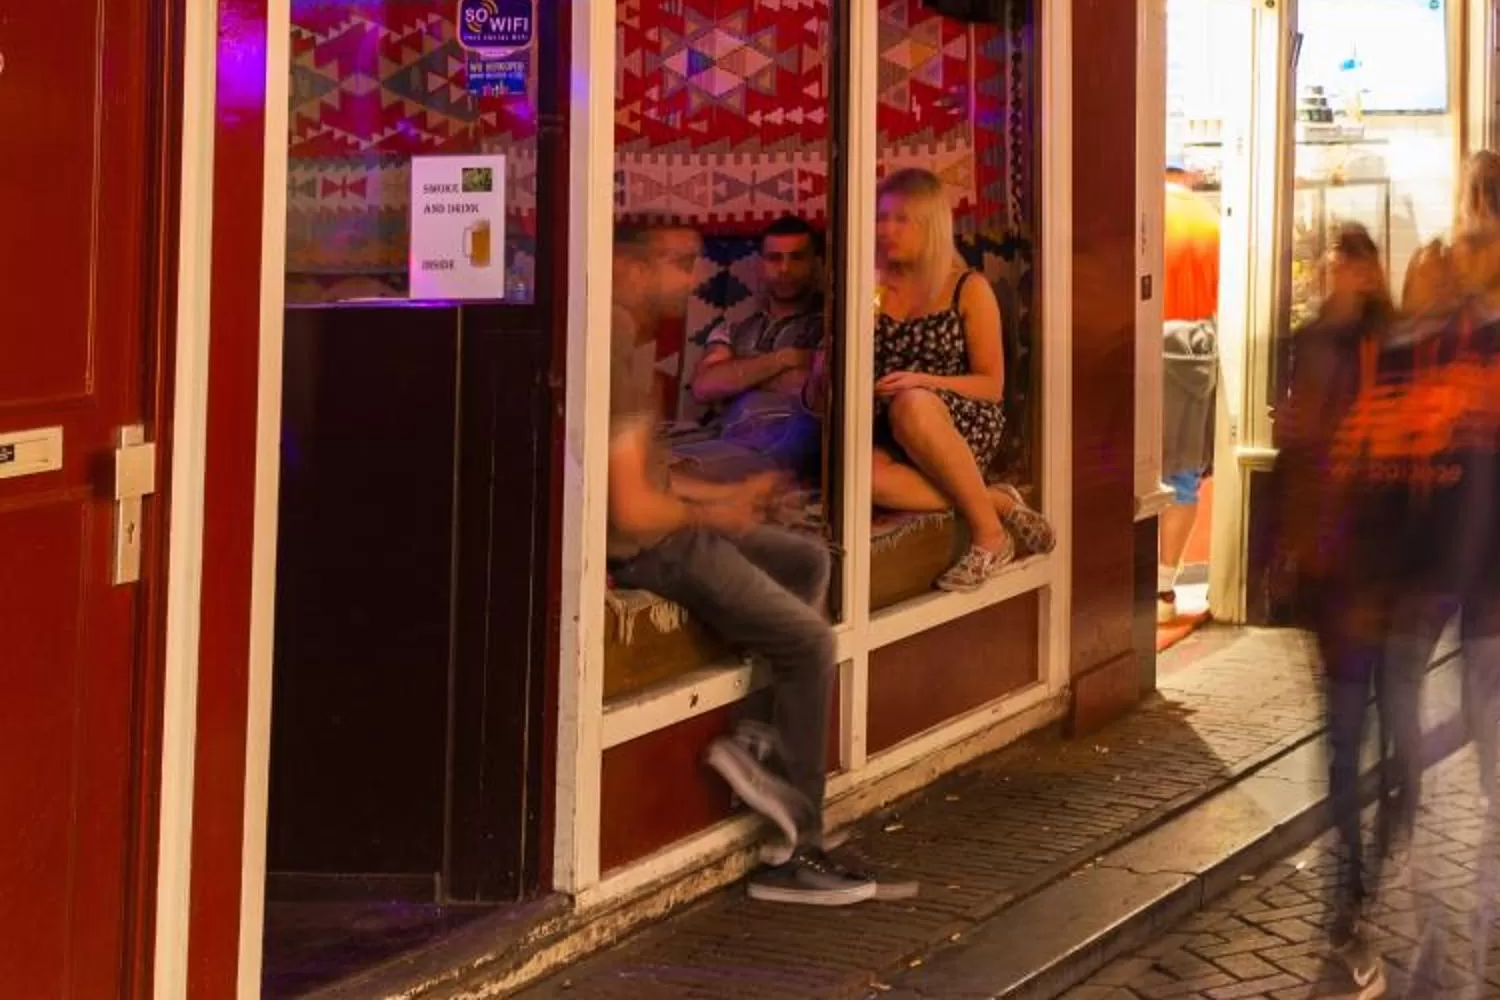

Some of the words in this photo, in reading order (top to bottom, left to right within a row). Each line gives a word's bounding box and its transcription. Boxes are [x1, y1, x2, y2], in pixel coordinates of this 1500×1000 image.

[465, 7, 489, 23] SO
[489, 17, 529, 33] WIFI
[423, 203, 446, 215] AND
[447, 203, 480, 214] DRINK
